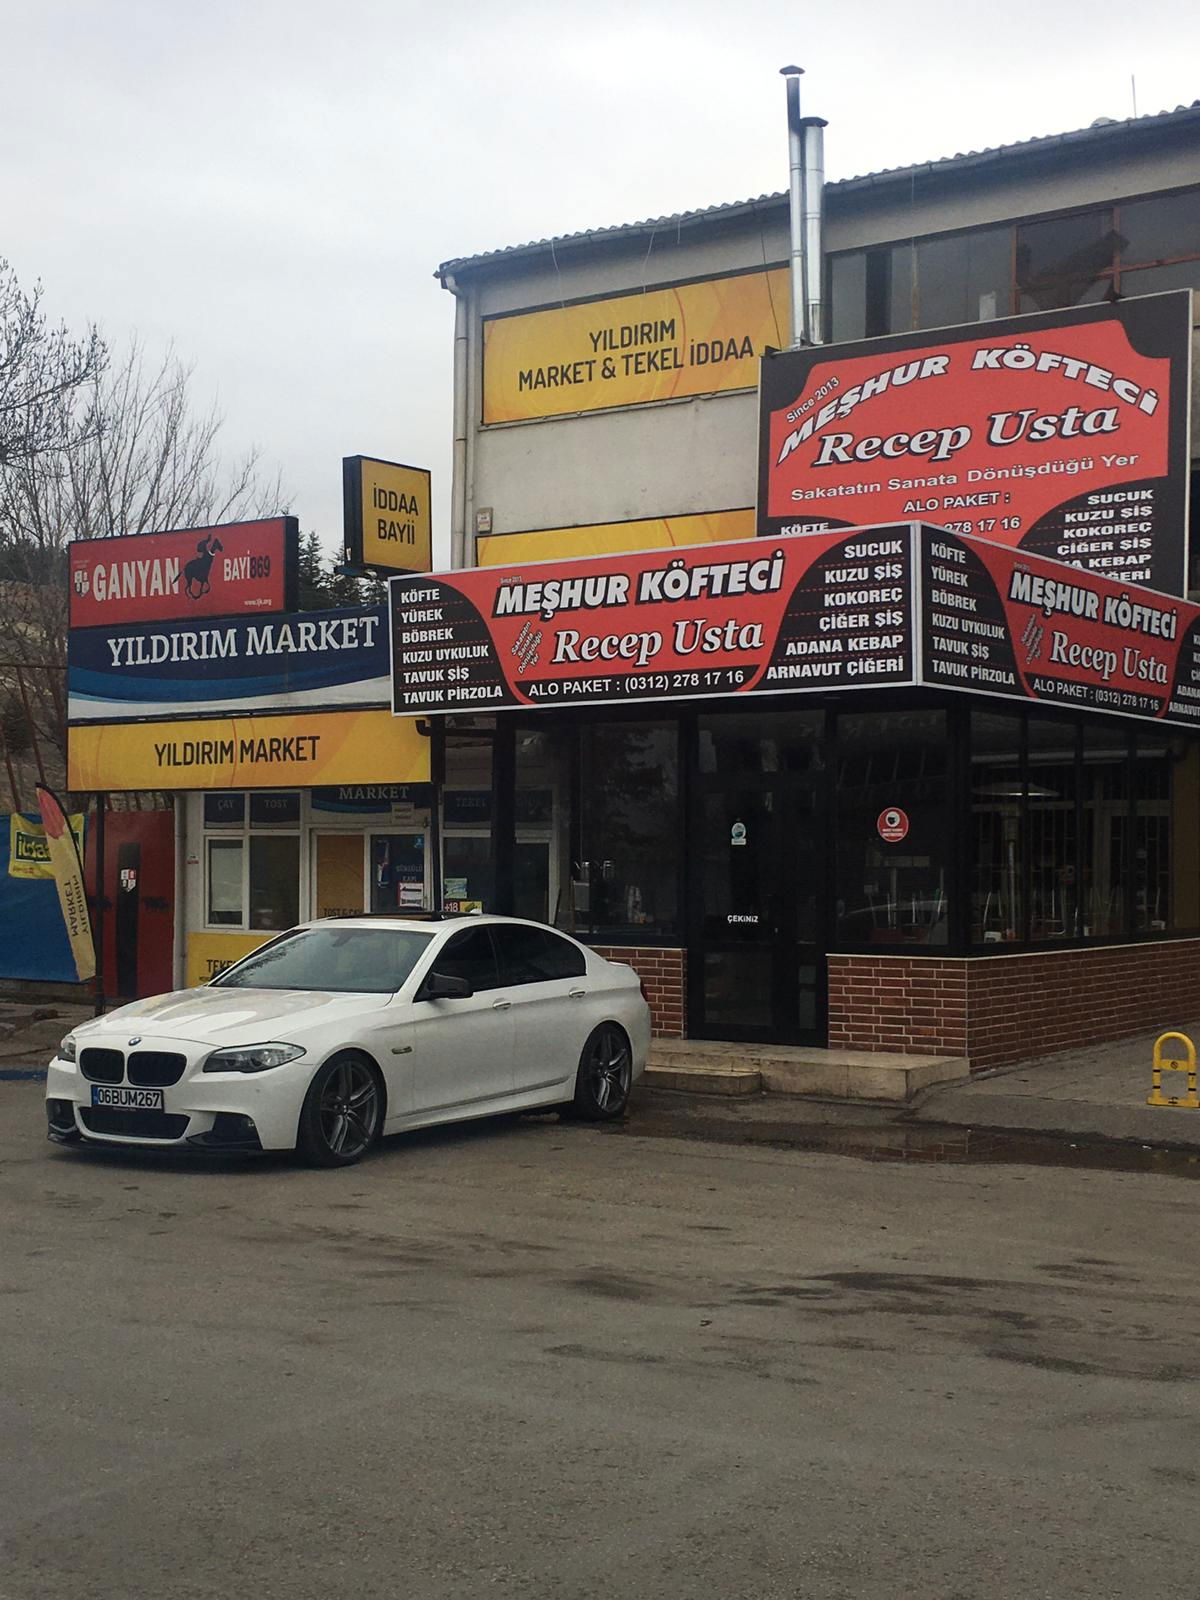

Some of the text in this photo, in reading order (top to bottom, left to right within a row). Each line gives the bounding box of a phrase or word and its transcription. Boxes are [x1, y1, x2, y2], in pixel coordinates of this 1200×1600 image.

[589, 318, 675, 353] YILDIRIM
[518, 336, 754, 392] MARKET & TEKEL İDDAA
[777, 344, 1159, 464] MEŞHUR KÖFTECİ
[786, 375, 840, 424] Since 2013
[811, 405, 1119, 467] Recep Usta
[791, 453, 1139, 501] Sakatatın Sanata Dönüşdüğü Yer
[372, 482, 419, 517] İDDAA
[903, 497, 939, 513] ALO
[943, 492, 1000, 511] PAKET
[1087, 489, 1154, 506] SUCUK
[1064, 504, 1152, 523] KUZU ŞİŞ
[780, 522, 829, 536] KÖFTE
[945, 516, 1020, 534] 278 17 16
[1063, 522, 1152, 539] KOKOREÇ
[844, 540, 903, 559] SUCUK
[930, 541, 966, 564] KÖFTE
[1057, 536, 1152, 556] ÇİĞER ŞİŞ
[1089, 554, 1152, 569] KEBAP
[93, 557, 180, 602] GANYAN
[496, 550, 784, 619] MEŞHUR KÖFTECİ
[825, 563, 903, 584] KUZU ŞİŞ
[930, 565, 968, 587] YÜREK
[401, 588, 440, 604] KÖFTE
[824, 588, 903, 607] KOKOREÇ
[931, 589, 977, 612] BÖBREK
[1010, 571, 1177, 640] MEŞHUR KÖFTECİ
[401, 608, 443, 624] YÜREK
[819, 610, 903, 632] ÇİĞER ŞİŞ
[932, 613, 1005, 640] KUZU UYKULUK
[106, 616, 379, 667] YILDIRIM MARKET
[402, 627, 454, 644] BÖBREK
[552, 618, 764, 666] Recep Usta
[785, 634, 904, 656] ADANA KEBAP
[403, 645, 489, 664] KUZU UYKULUK
[932, 636, 989, 660] TAVUK ŞİŞ
[1049, 630, 1117, 681] Recep
[1123, 647, 1168, 684] Usta
[403, 666, 470, 684] TAVUK ŞİŞ
[766, 657, 904, 680] ARNAVUT ÇİĞERİ
[932, 659, 1015, 686] TAVUK PİRZOLA
[403, 685, 503, 704] TAVUK PİRZOLA
[528, 682, 559, 697] ALO
[563, 679, 612, 695] PAKET
[625, 675, 669, 693] (0312)
[673, 673, 699, 687] 278
[704, 671, 720, 686] 17
[727, 670, 744, 684] 16
[1033, 678, 1055, 694] ALO
[1057, 682, 1087, 701] PAKET
[1095, 688, 1121, 707] (0312)
[1122, 694, 1137, 707] 278
[1139, 697, 1148, 708] 17
[1149, 699, 1159, 711] 16
[154, 736, 321, 767] YILDIRIM MARKET
[339, 786, 410, 800] MARKET
[727, 914, 759, 924] ÇEKİNİZ
